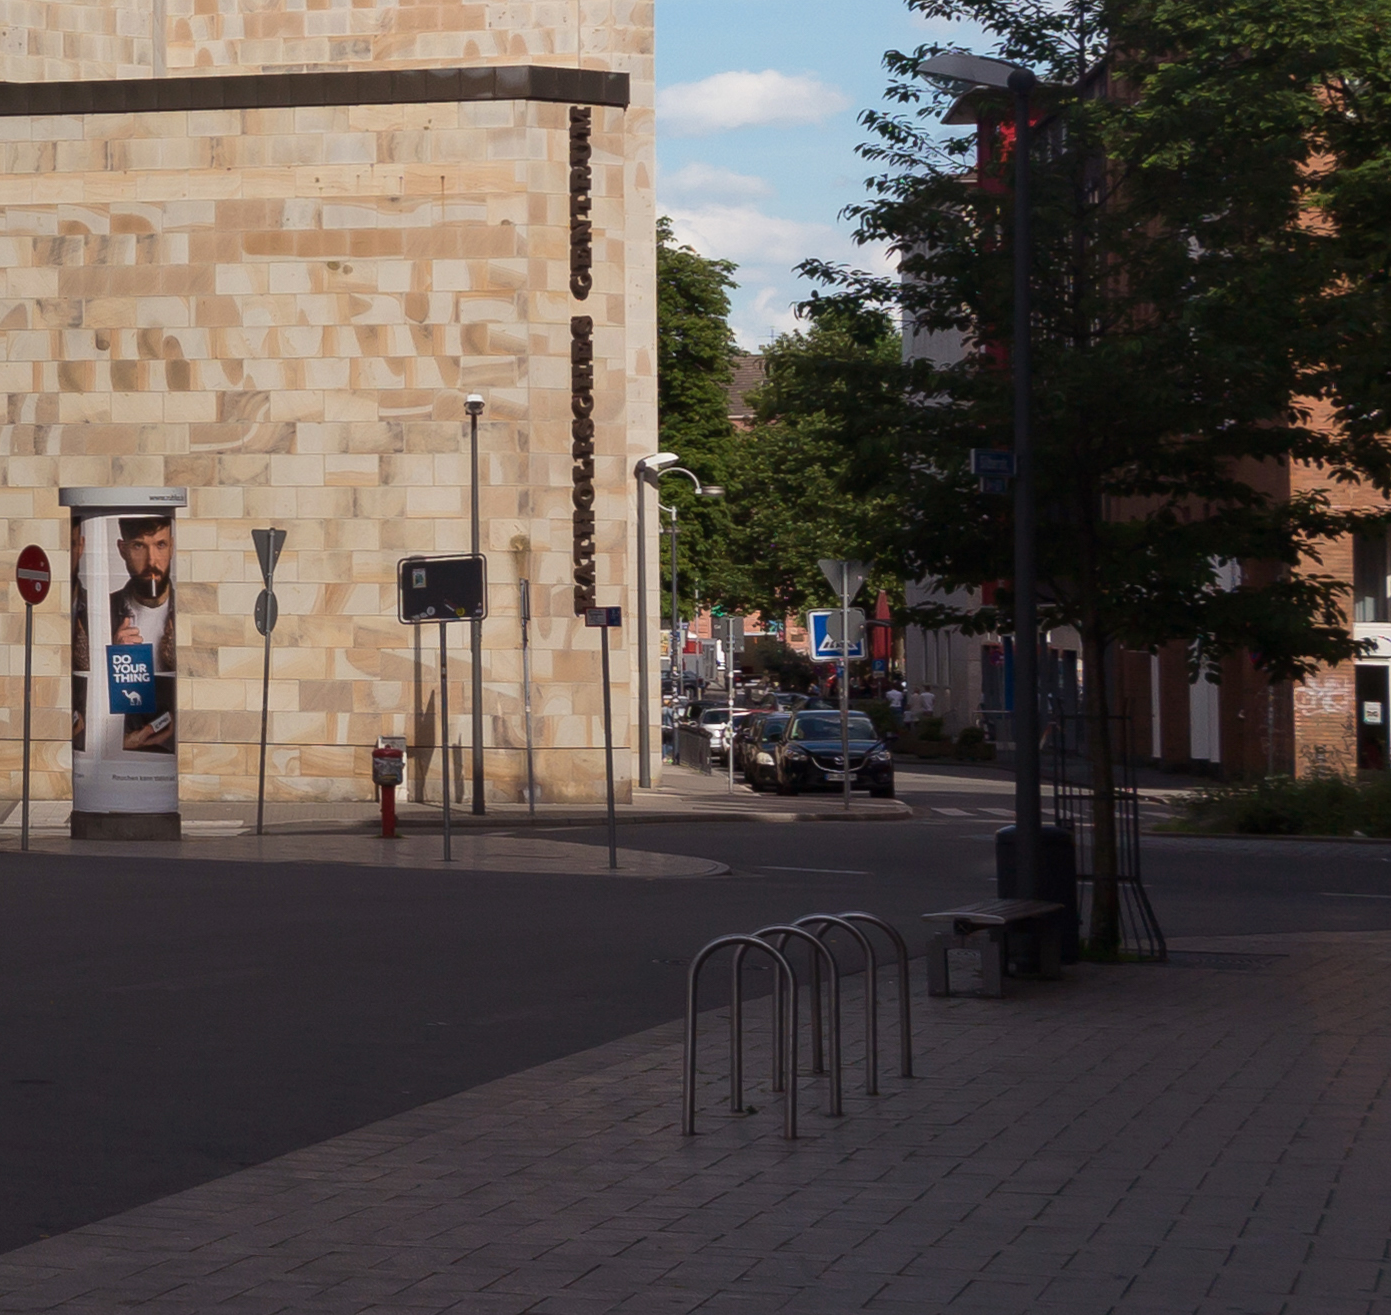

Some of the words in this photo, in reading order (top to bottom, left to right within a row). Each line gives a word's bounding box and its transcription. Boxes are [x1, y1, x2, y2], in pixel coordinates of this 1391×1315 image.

[570, 106, 592, 300] CENTRUM
[570, 315, 596, 616] KATHOLISCHES
[112, 654, 132, 664] DO
[113, 663, 147, 673] YOUR
[113, 673, 150, 683] THING
